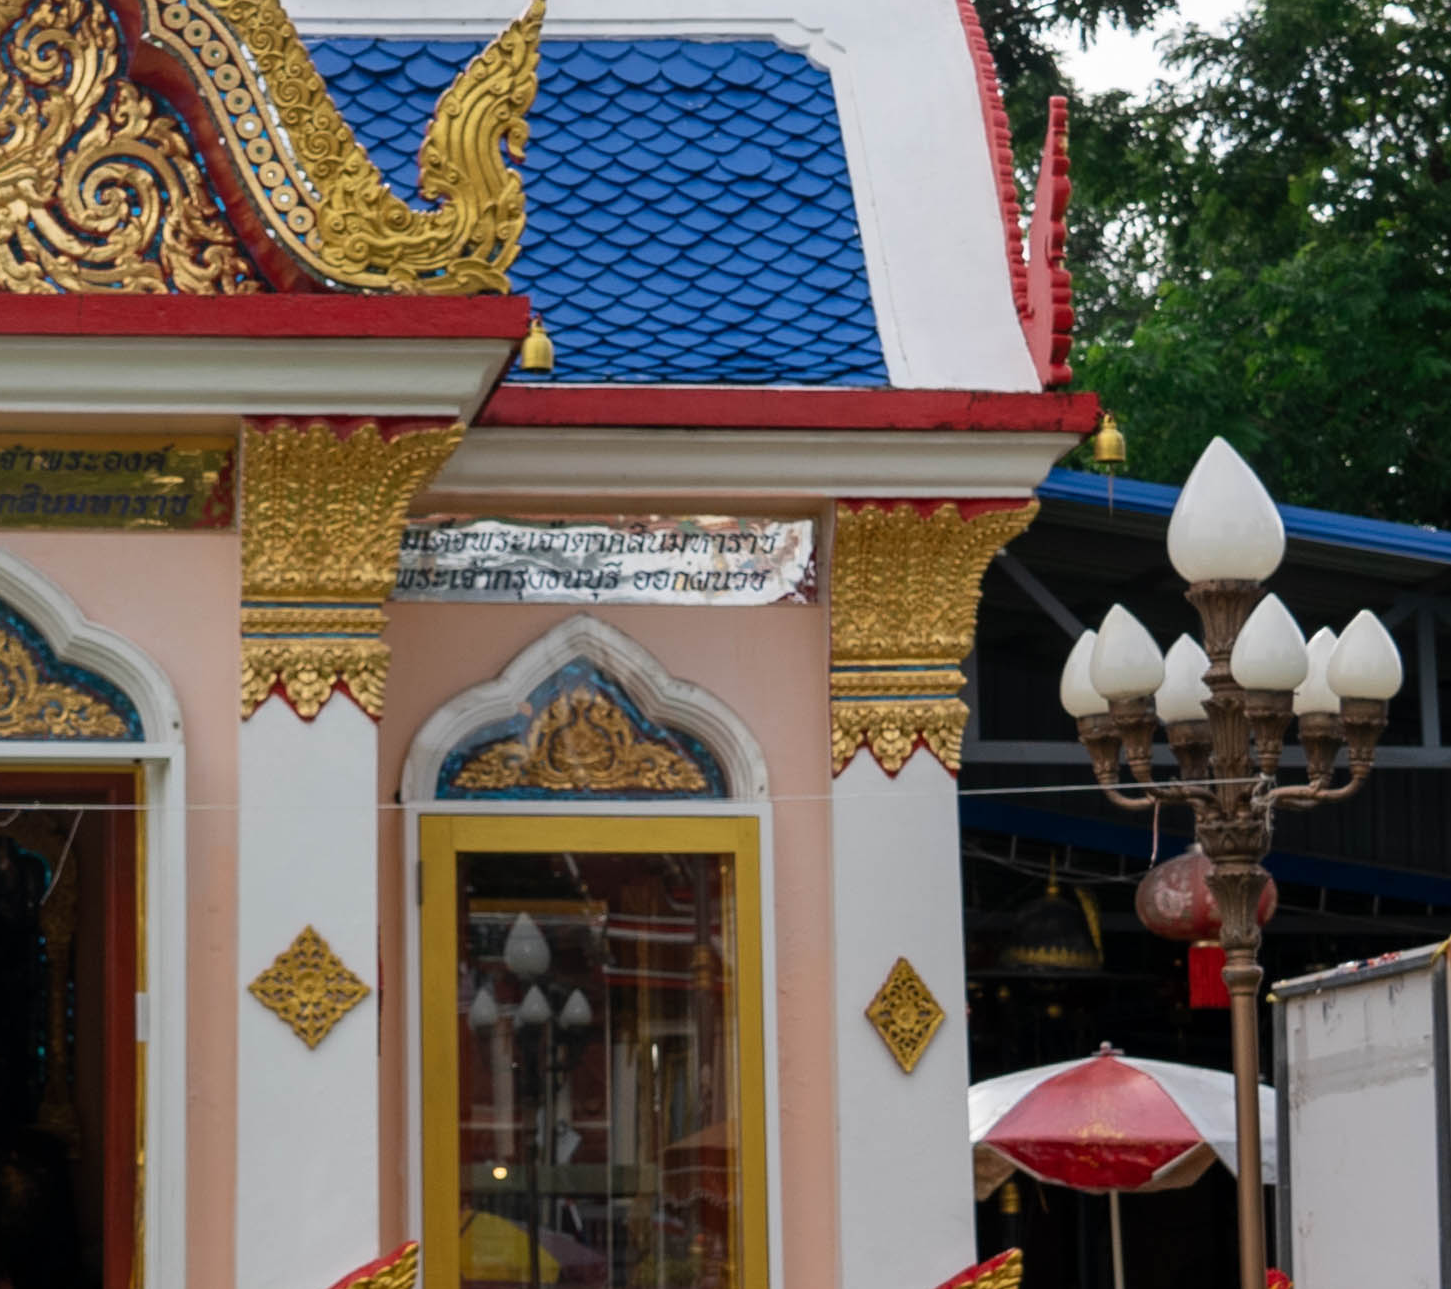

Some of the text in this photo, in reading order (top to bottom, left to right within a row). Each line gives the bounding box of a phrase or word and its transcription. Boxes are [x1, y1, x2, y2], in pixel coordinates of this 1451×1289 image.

[400, 518, 781, 555] มเด็จพระเจ้าตากสินมหาราช
